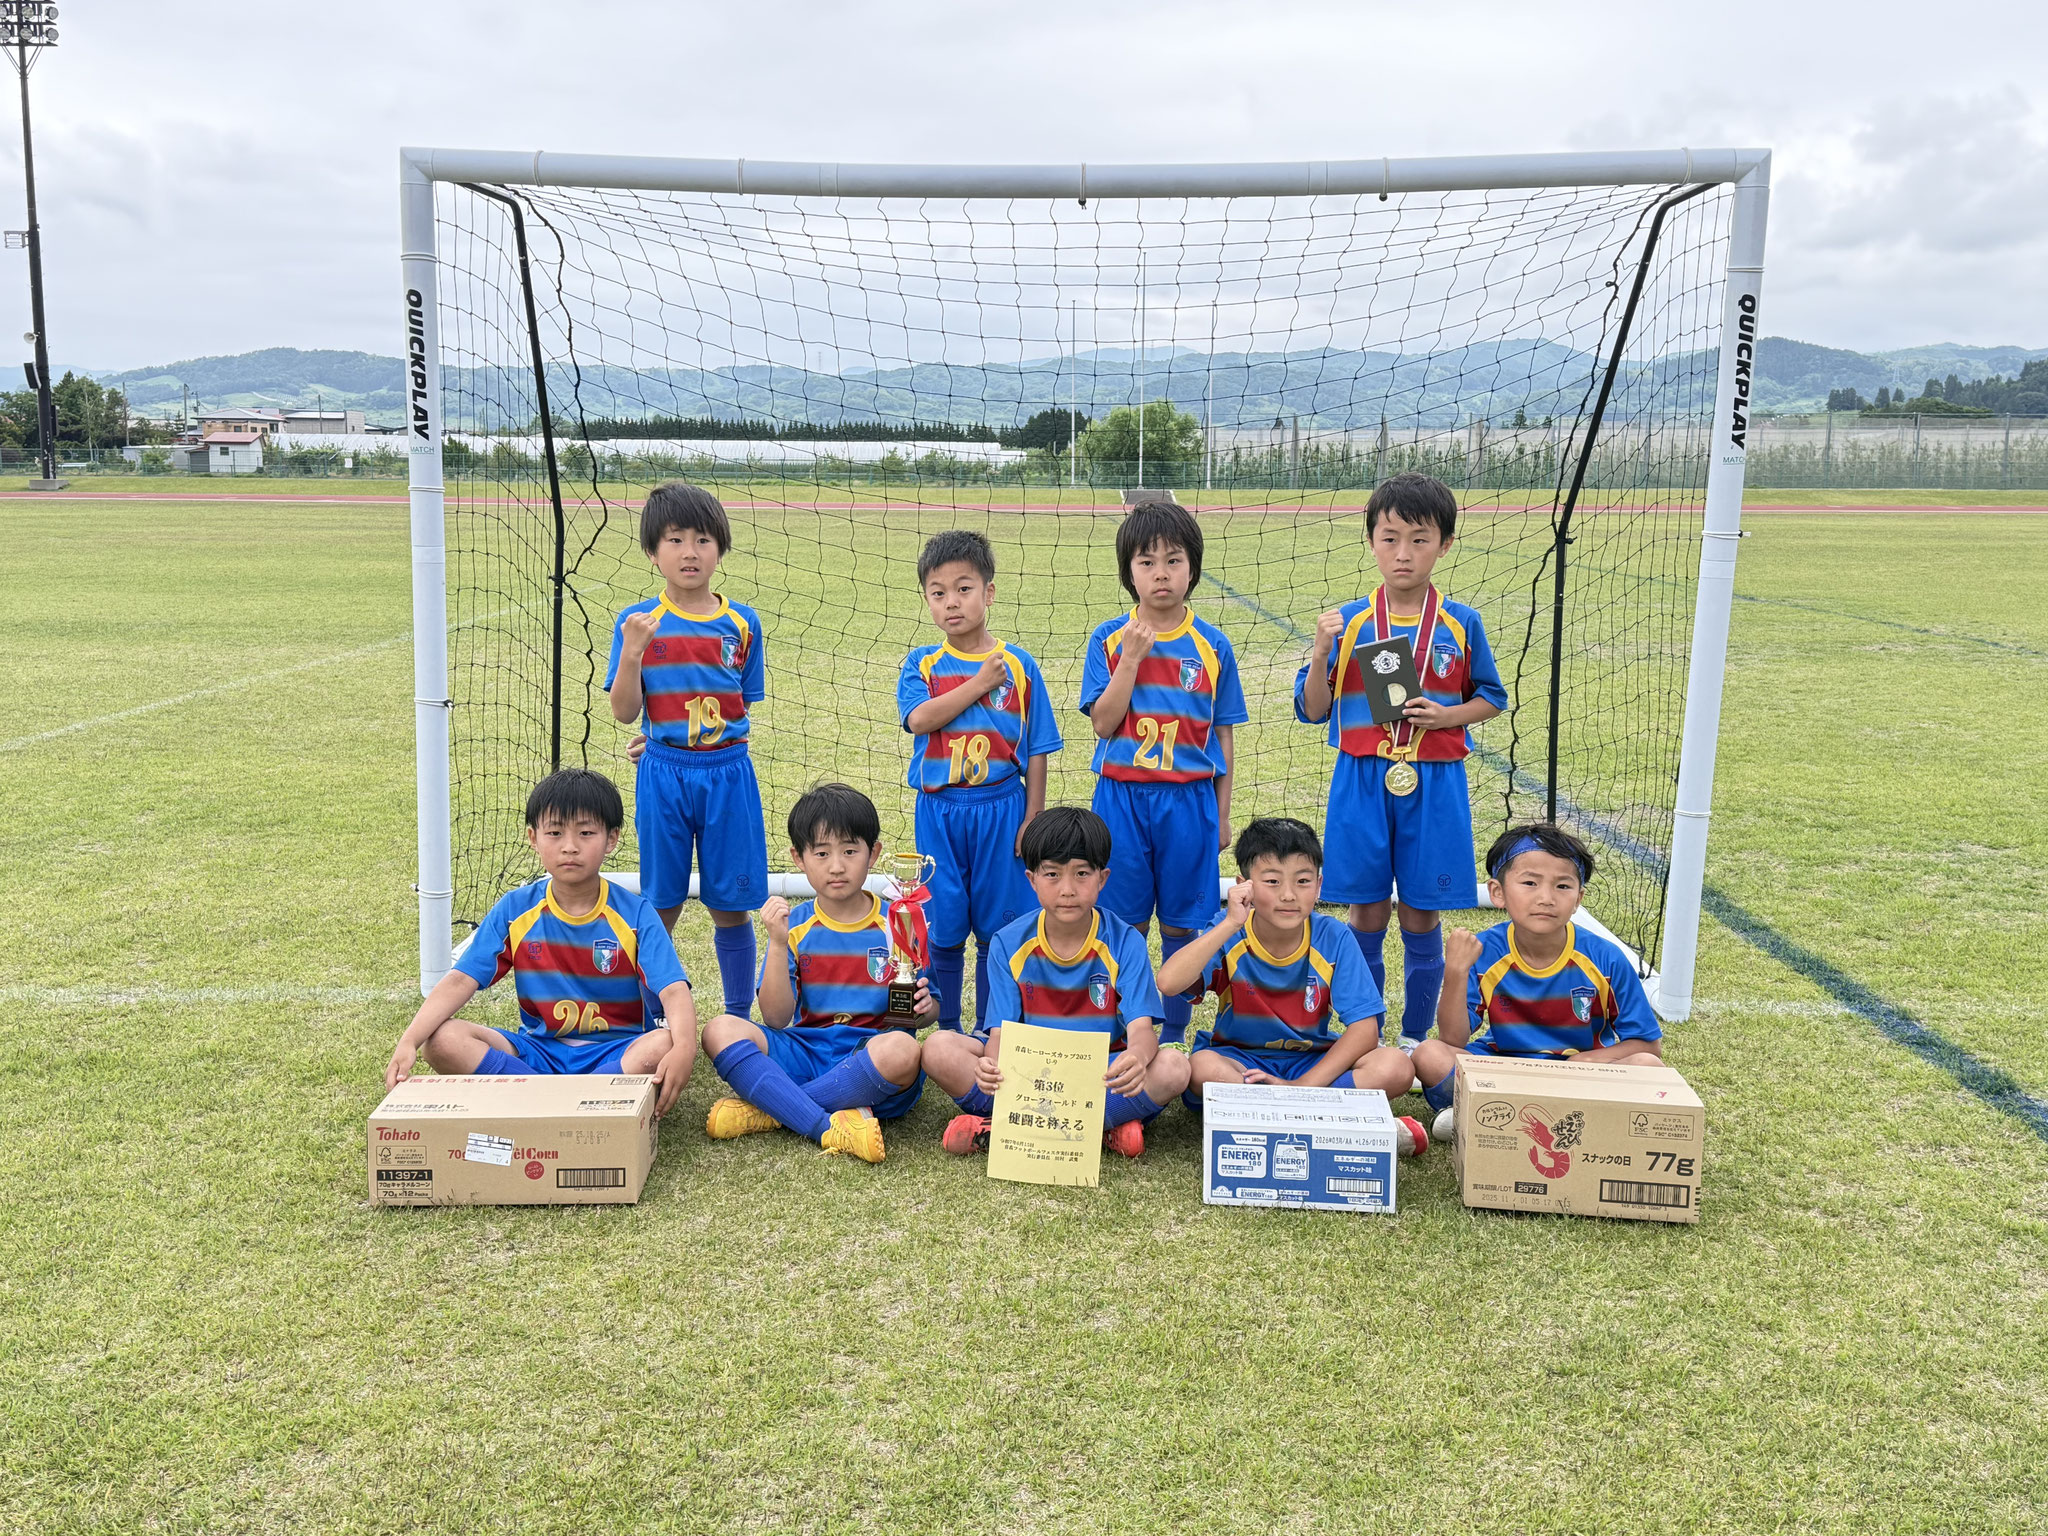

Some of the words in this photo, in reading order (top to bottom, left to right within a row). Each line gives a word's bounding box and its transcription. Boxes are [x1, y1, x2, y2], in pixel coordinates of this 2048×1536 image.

[406, 288, 430, 442] QUICKPLAY
[1731, 293, 1757, 450] QUICKPLAY
[684, 695, 727, 748] 19
[1133, 717, 1180, 771] 21
[948, 734, 991, 786] 18
[1033, 1078, 1065, 1093] 第3位
[1015, 1093, 1078, 1108] グローフィールド
[1009, 1111, 1084, 1131] 健闘を称える
[1481, 1112, 1511, 1124] ノンフライ
[376, 1126, 421, 1141] Tohato
[1221, 1150, 1263, 1161] ENERGY
[1276, 1157, 1306, 1166] ENERGY
[1582, 1153, 1632, 1167] スナックの日
[1337, 1166, 1373, 1174] マスカット味
[1645, 1151, 1695, 1177] 77g
[381, 1171, 428, 1180] 11397-1
[1517, 1184, 1544, 1194] 29776
